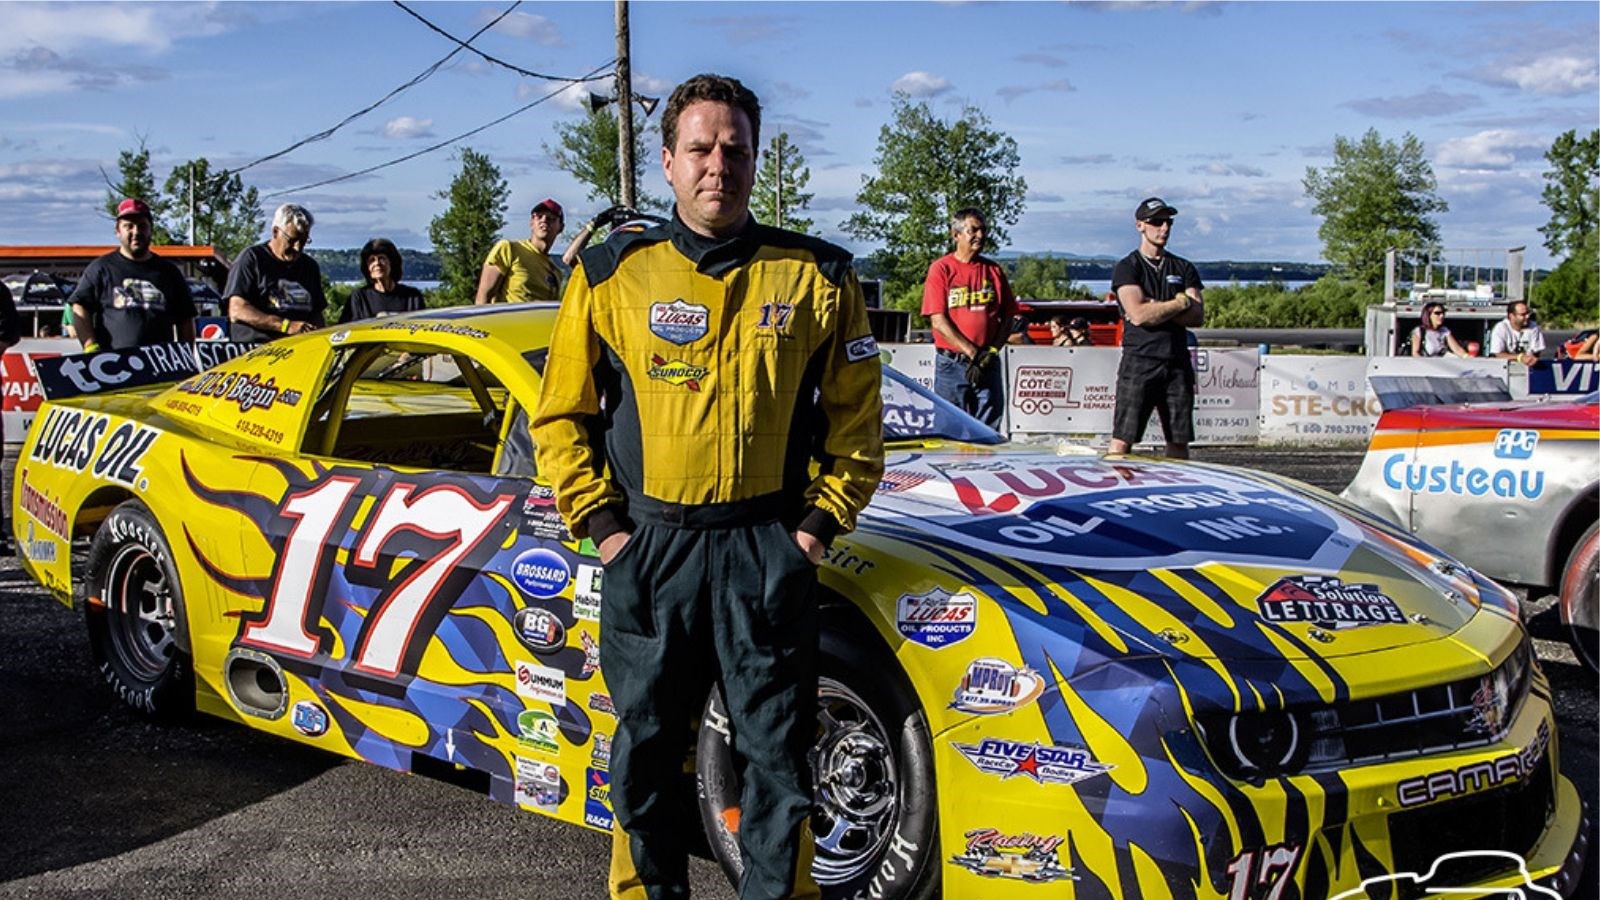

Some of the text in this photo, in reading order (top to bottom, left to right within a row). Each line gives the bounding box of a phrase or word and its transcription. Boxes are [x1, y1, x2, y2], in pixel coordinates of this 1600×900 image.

[656, 309, 704, 326] LUCAS
[758, 302, 793, 330] 17
[651, 366, 704, 378] SUNOCO
[1020, 369, 1068, 377] REMORQUE
[1201, 365, 1259, 389] Michaud
[1324, 424, 1368, 434] 790-3790
[32, 407, 159, 485] LUCAS OIL
[1383, 453, 1544, 499] Custeau
[998, 513, 1104, 544] OIL
[1186, 515, 1295, 542] INC.
[241, 474, 516, 679] 17
[516, 563, 566, 583] BROSSARD
[1314, 587, 1390, 605] Solution
[906, 606, 972, 622] LUCAS
[1264, 600, 1403, 622] LETTRAGE
[524, 612, 551, 634] BG
[901, 625, 971, 633] OIL PRODUCTS
[926, 635, 947, 643] INC.
[518, 665, 564, 690] SUMMUM
[978, 740, 1086, 769] FIVE STAR
[976, 757, 1075, 778] RaceCar Bodies
[964, 828, 1064, 852] Racing
[1227, 845, 1299, 900] 17
